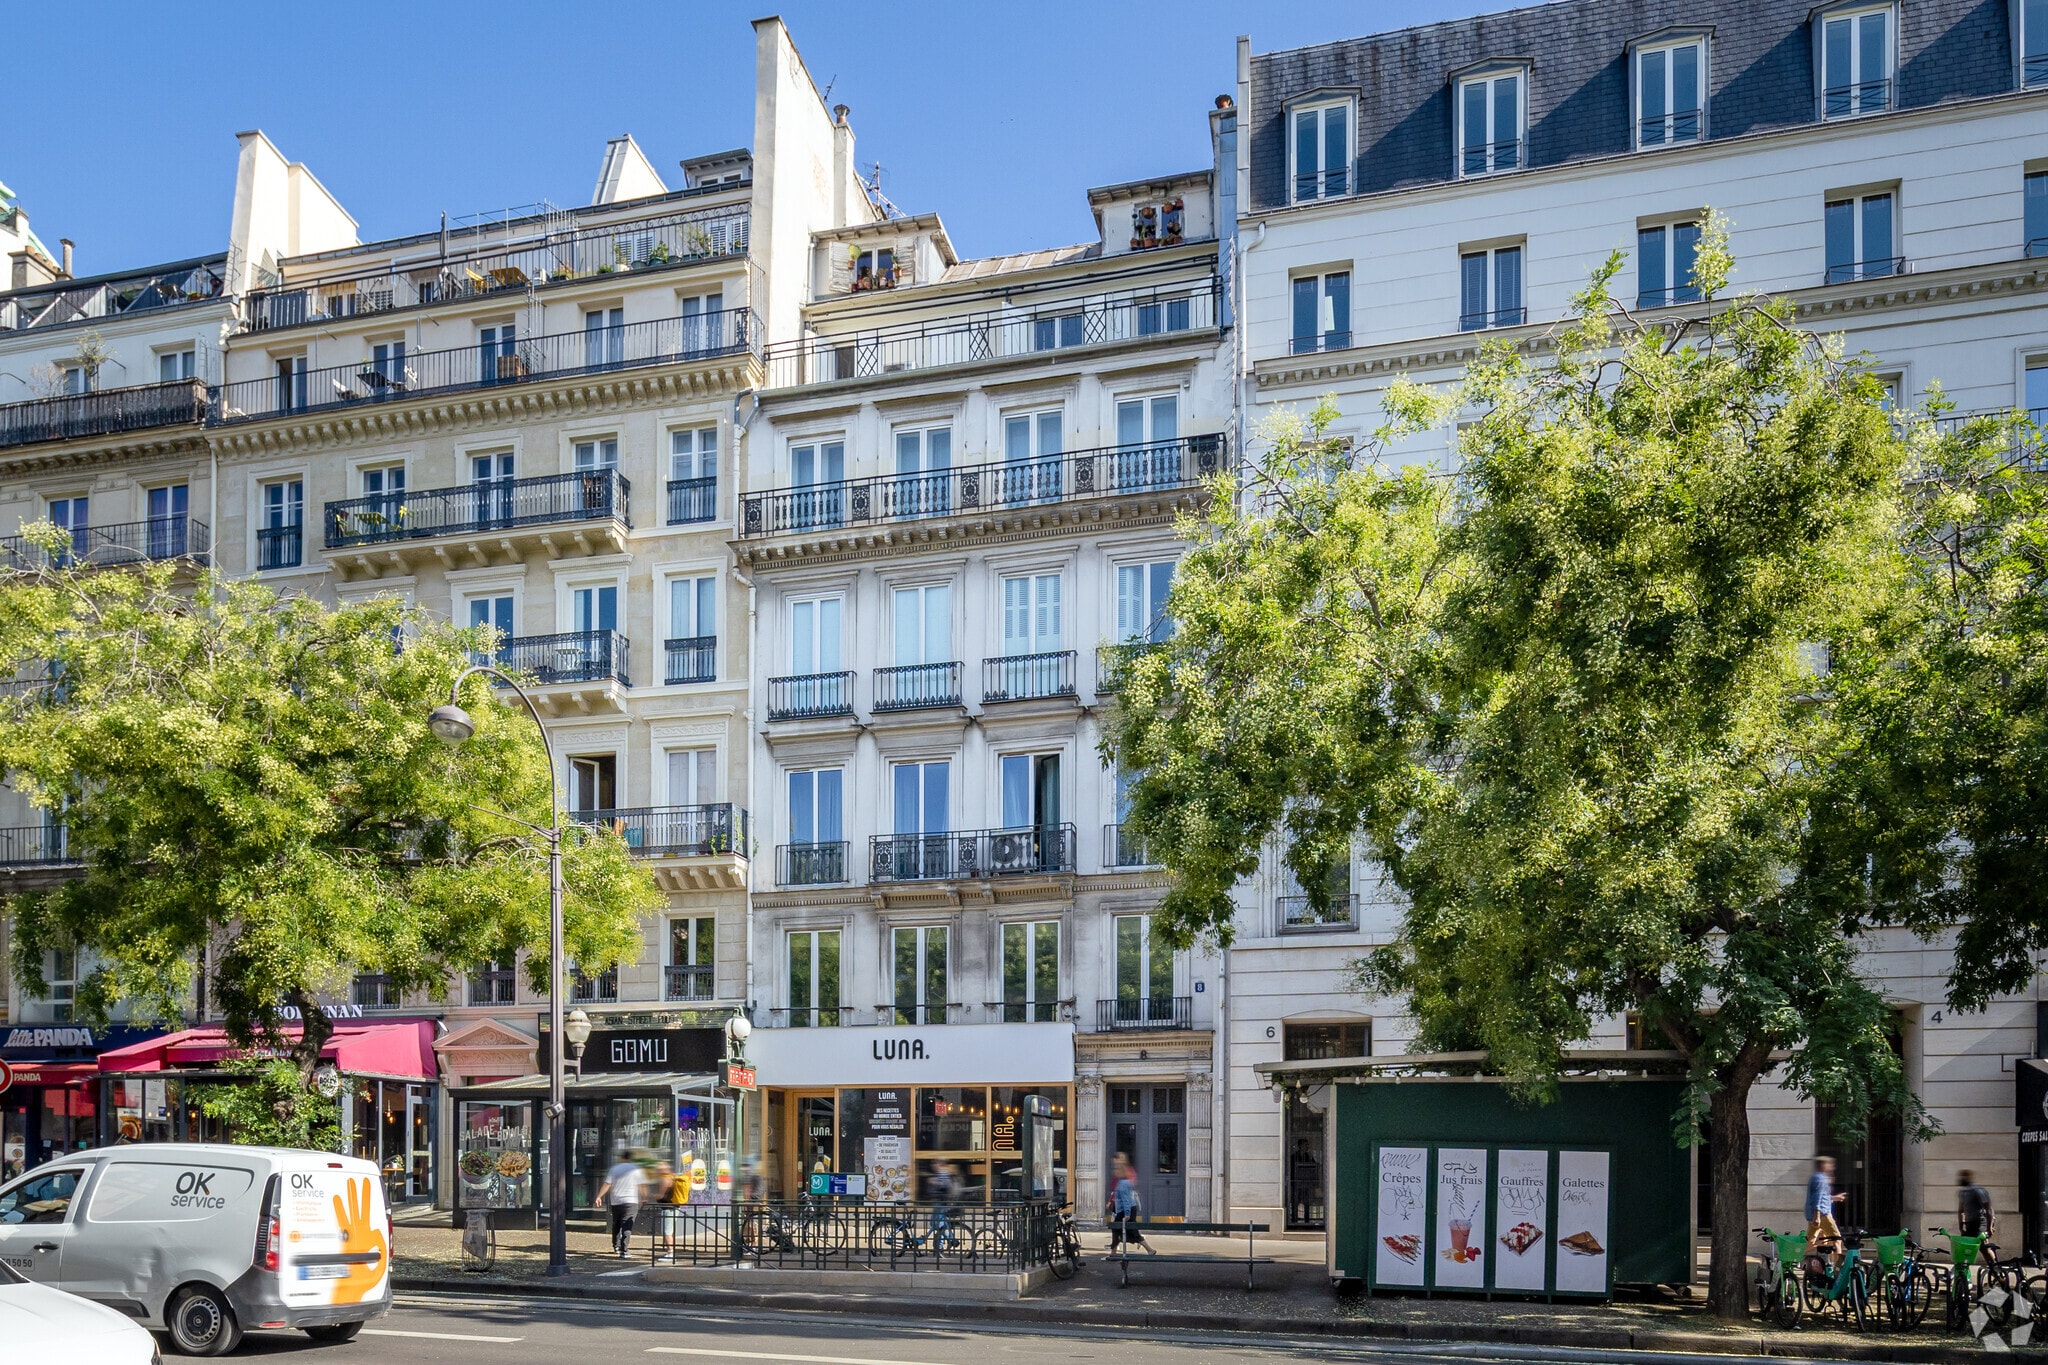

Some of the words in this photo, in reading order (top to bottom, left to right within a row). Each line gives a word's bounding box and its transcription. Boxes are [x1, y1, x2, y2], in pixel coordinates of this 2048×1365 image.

[628, 1016, 651, 1024] STREET
[1931, 1010, 1943, 1024] 4
[33, 1028, 93, 1046] PANDA
[1266, 1026, 1276, 1038] 6
[611, 1039, 668, 1063] GOMU
[1140, 1050, 1148, 1060] 8
[14, 1072, 41, 1082] PANDA
[460, 1124, 495, 1140] SALADE
[176, 1172, 216, 1195] OK
[291, 1174, 314, 1189] OK
[1382, 1172, 1422, 1185] Crêpes
[1440, 1174, 1457, 1184] Jus
[1460, 1174, 1483, 1184] frais
[1500, 1176, 1544, 1186] Gauffres
[1562, 1178, 1605, 1188] Galettes
[292, 1189, 324, 1198] service
[170, 1194, 225, 1209] service
[12, 1259, 22, 1267] 50
[22, 1260, 32, 1268] 50
